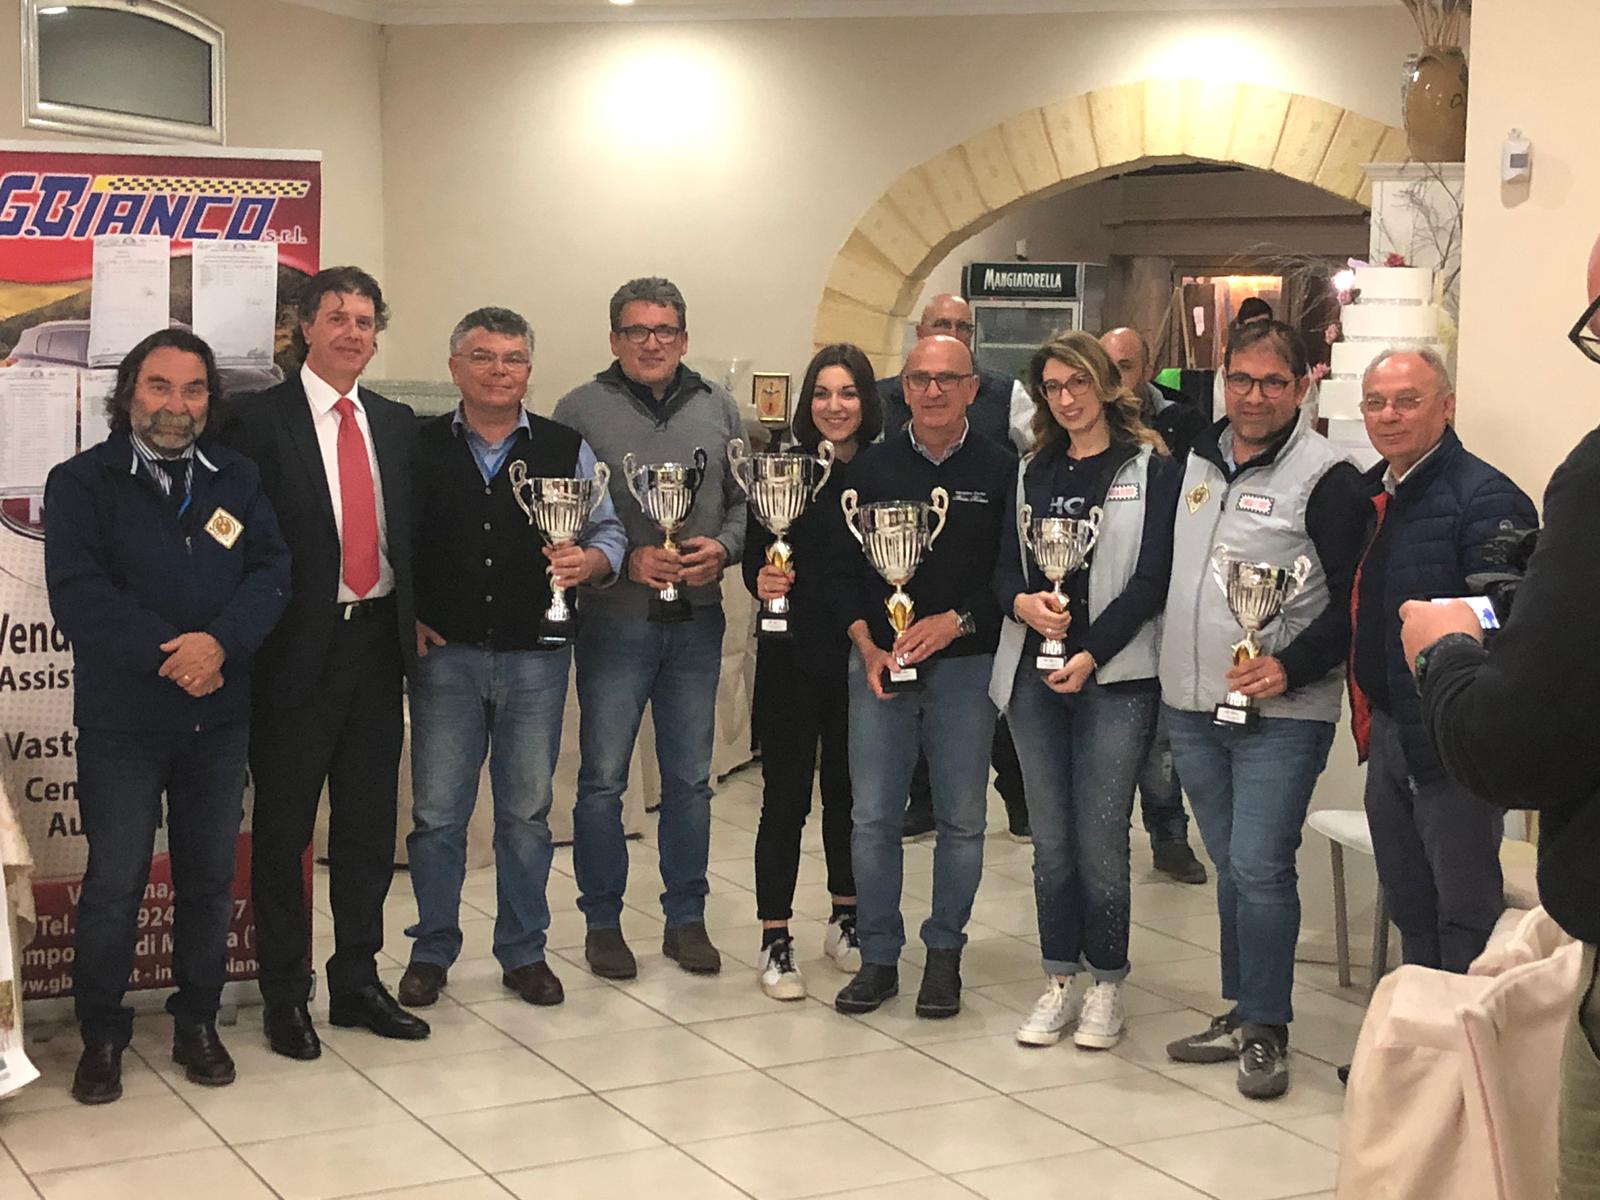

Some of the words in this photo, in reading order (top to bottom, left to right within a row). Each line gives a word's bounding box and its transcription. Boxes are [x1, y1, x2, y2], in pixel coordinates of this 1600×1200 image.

[265, 226, 307, 245] s.r.l.
[0, 662, 75, 692] Assis
[38, 913, 76, 936] Tel.
[135, 933, 156, 956] di
